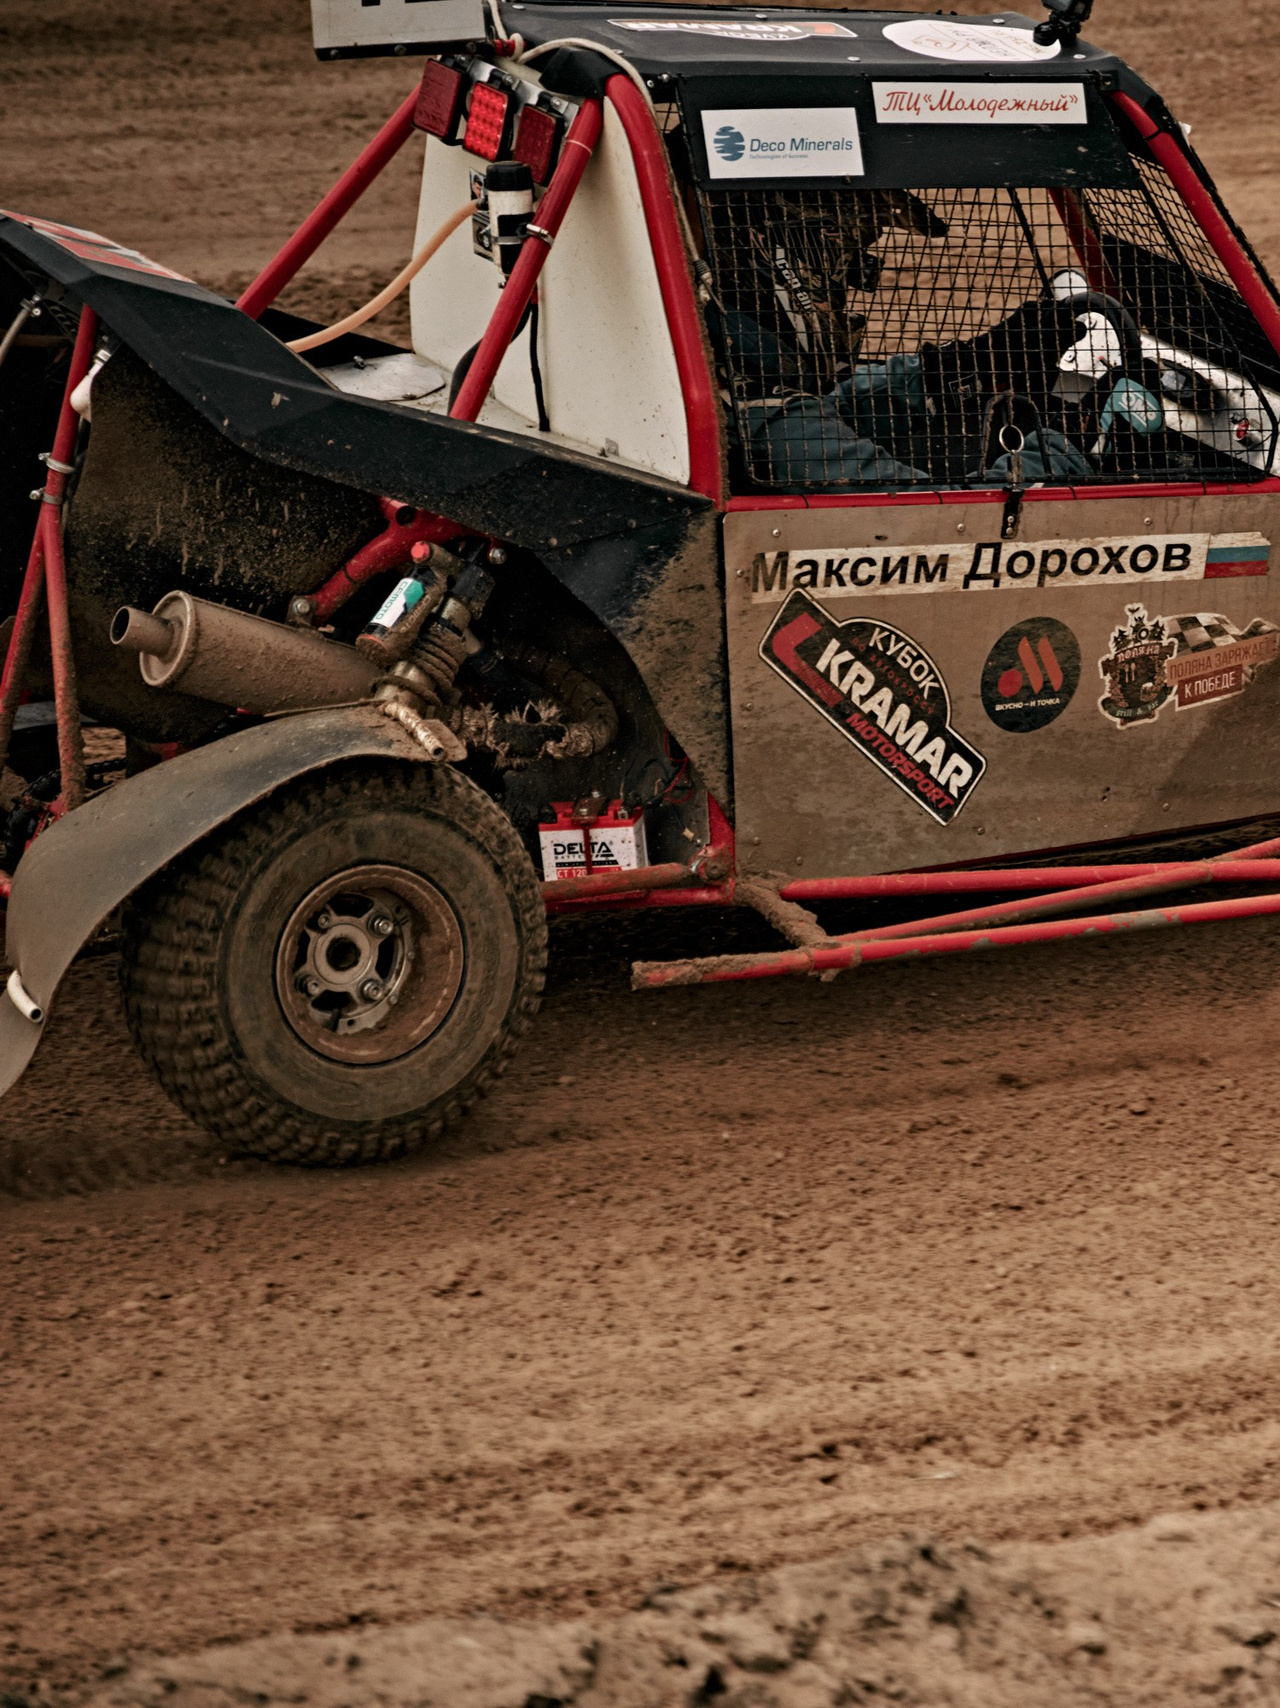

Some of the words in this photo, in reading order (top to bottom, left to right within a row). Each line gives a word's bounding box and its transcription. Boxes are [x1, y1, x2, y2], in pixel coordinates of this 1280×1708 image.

[750, 138, 786, 152] Deco
[790, 137, 853, 151] Minerals
[1121, 391, 1157, 421] OMP
[752, 550, 950, 593] Максим
[962, 541, 1192, 589] Дорохов
[868, 627, 940, 700] КУБОК
[1169, 657, 1213, 679] ПОЛЯНА
[1184, 683, 1193, 699] К
[1194, 670, 1236, 696] ПОБЕДЕ
[815, 637, 973, 800] KRAMAR
[846, 712, 955, 810] MOTORSPORT
[553, 841, 615, 858] DELTA
[557, 869, 569, 878] CT
